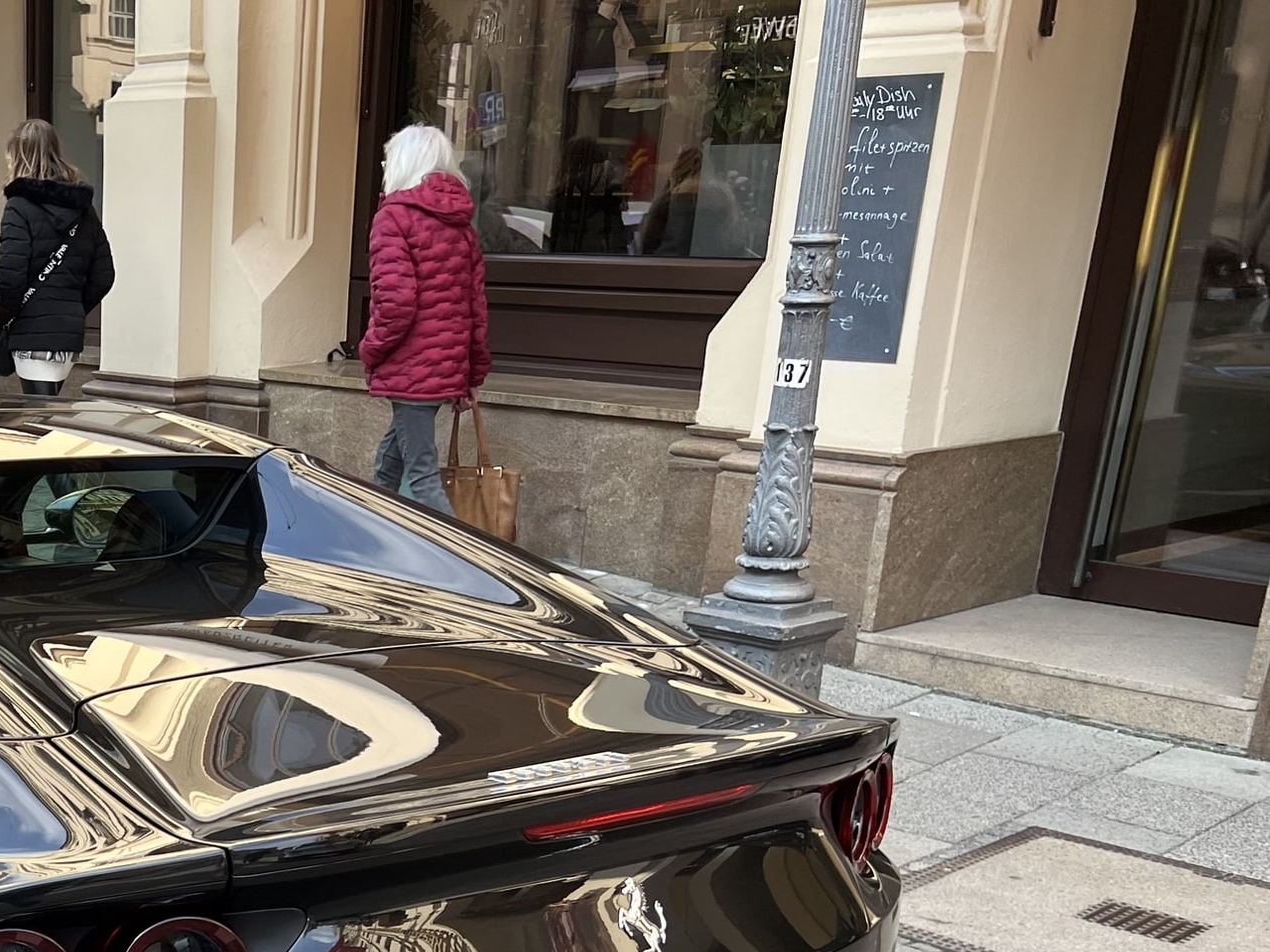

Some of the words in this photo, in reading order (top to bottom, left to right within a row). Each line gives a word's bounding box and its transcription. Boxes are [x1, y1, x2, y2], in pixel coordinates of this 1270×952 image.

[876, 85, 916, 104] Dish
[841, 175, 876, 196] olini
[836, 250, 851, 260] en
[851, 280, 890, 307] Kaffee
